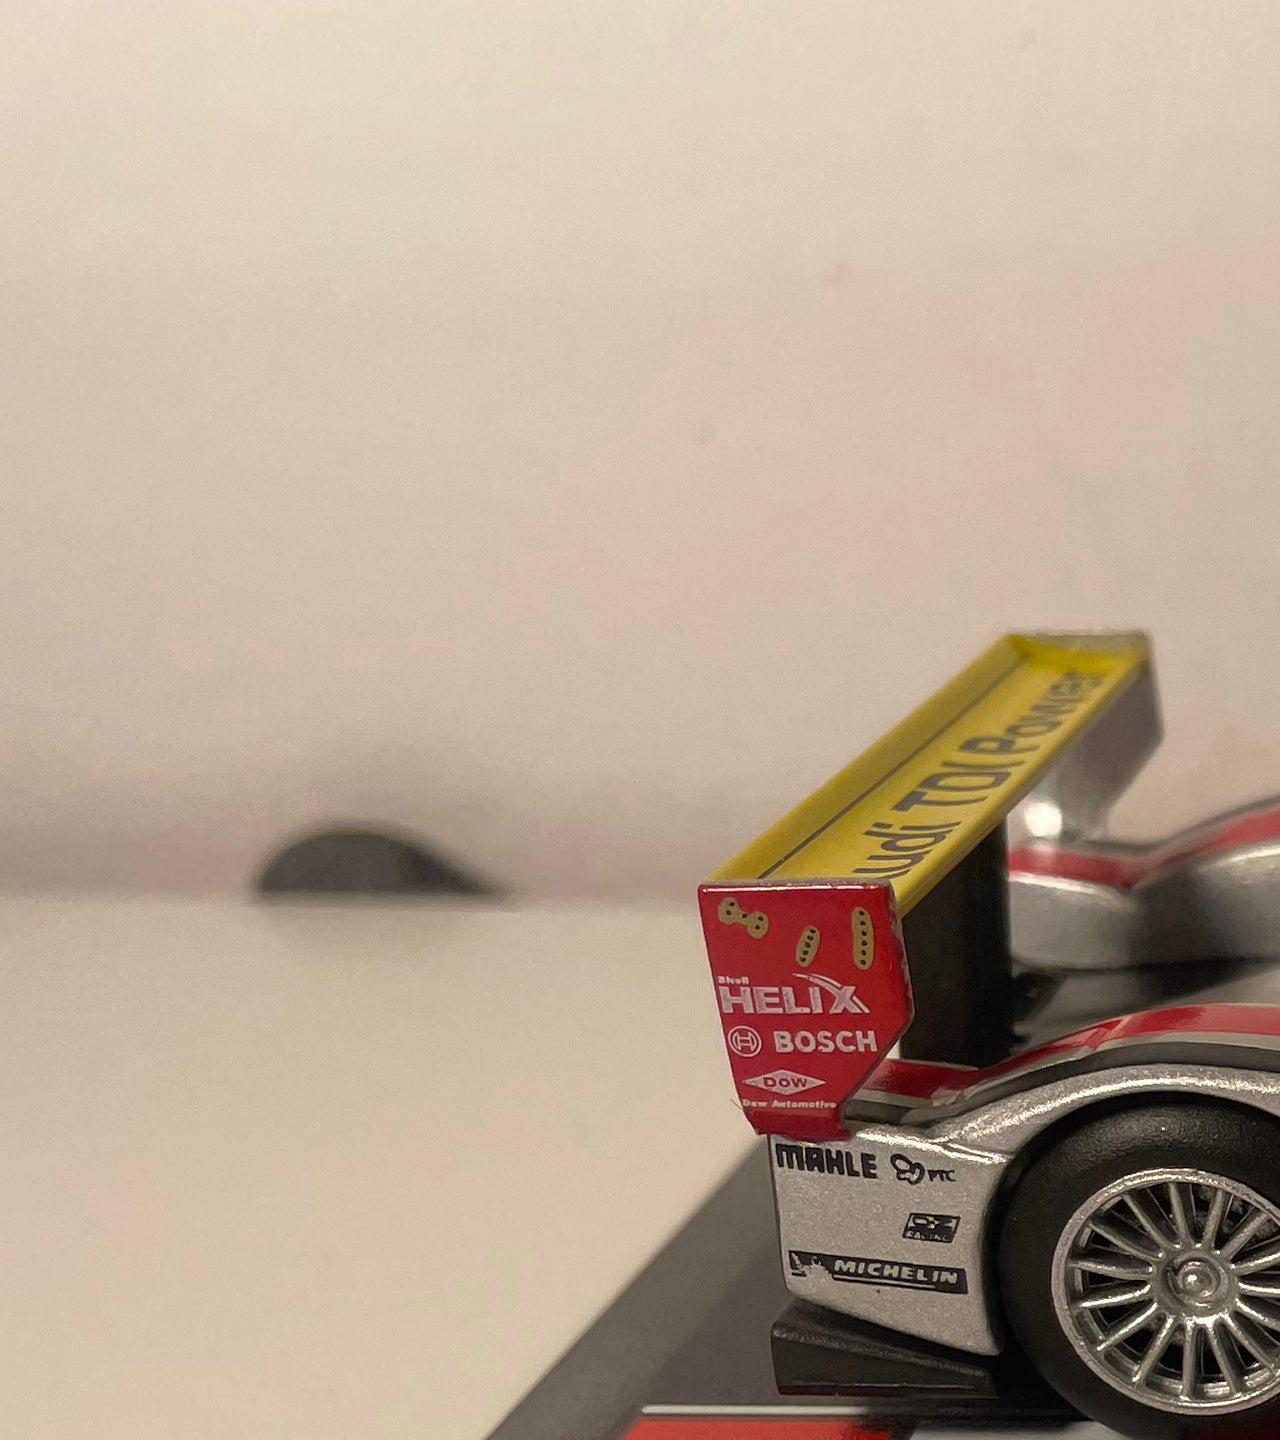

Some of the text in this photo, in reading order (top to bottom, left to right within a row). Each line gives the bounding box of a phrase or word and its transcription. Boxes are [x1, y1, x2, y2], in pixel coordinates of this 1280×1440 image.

[891, 760, 1026, 812] TDI
[852, 821, 962, 879] udi
[718, 973, 870, 1014] HELIX
[773, 1030, 878, 1052] BOSCH
[763, 1077, 808, 1088] DOW
[771, 1100, 837, 1108] Automotive
[775, 1143, 878, 1179] MAHLE
[834, 1259, 958, 1284] MICHELIN
